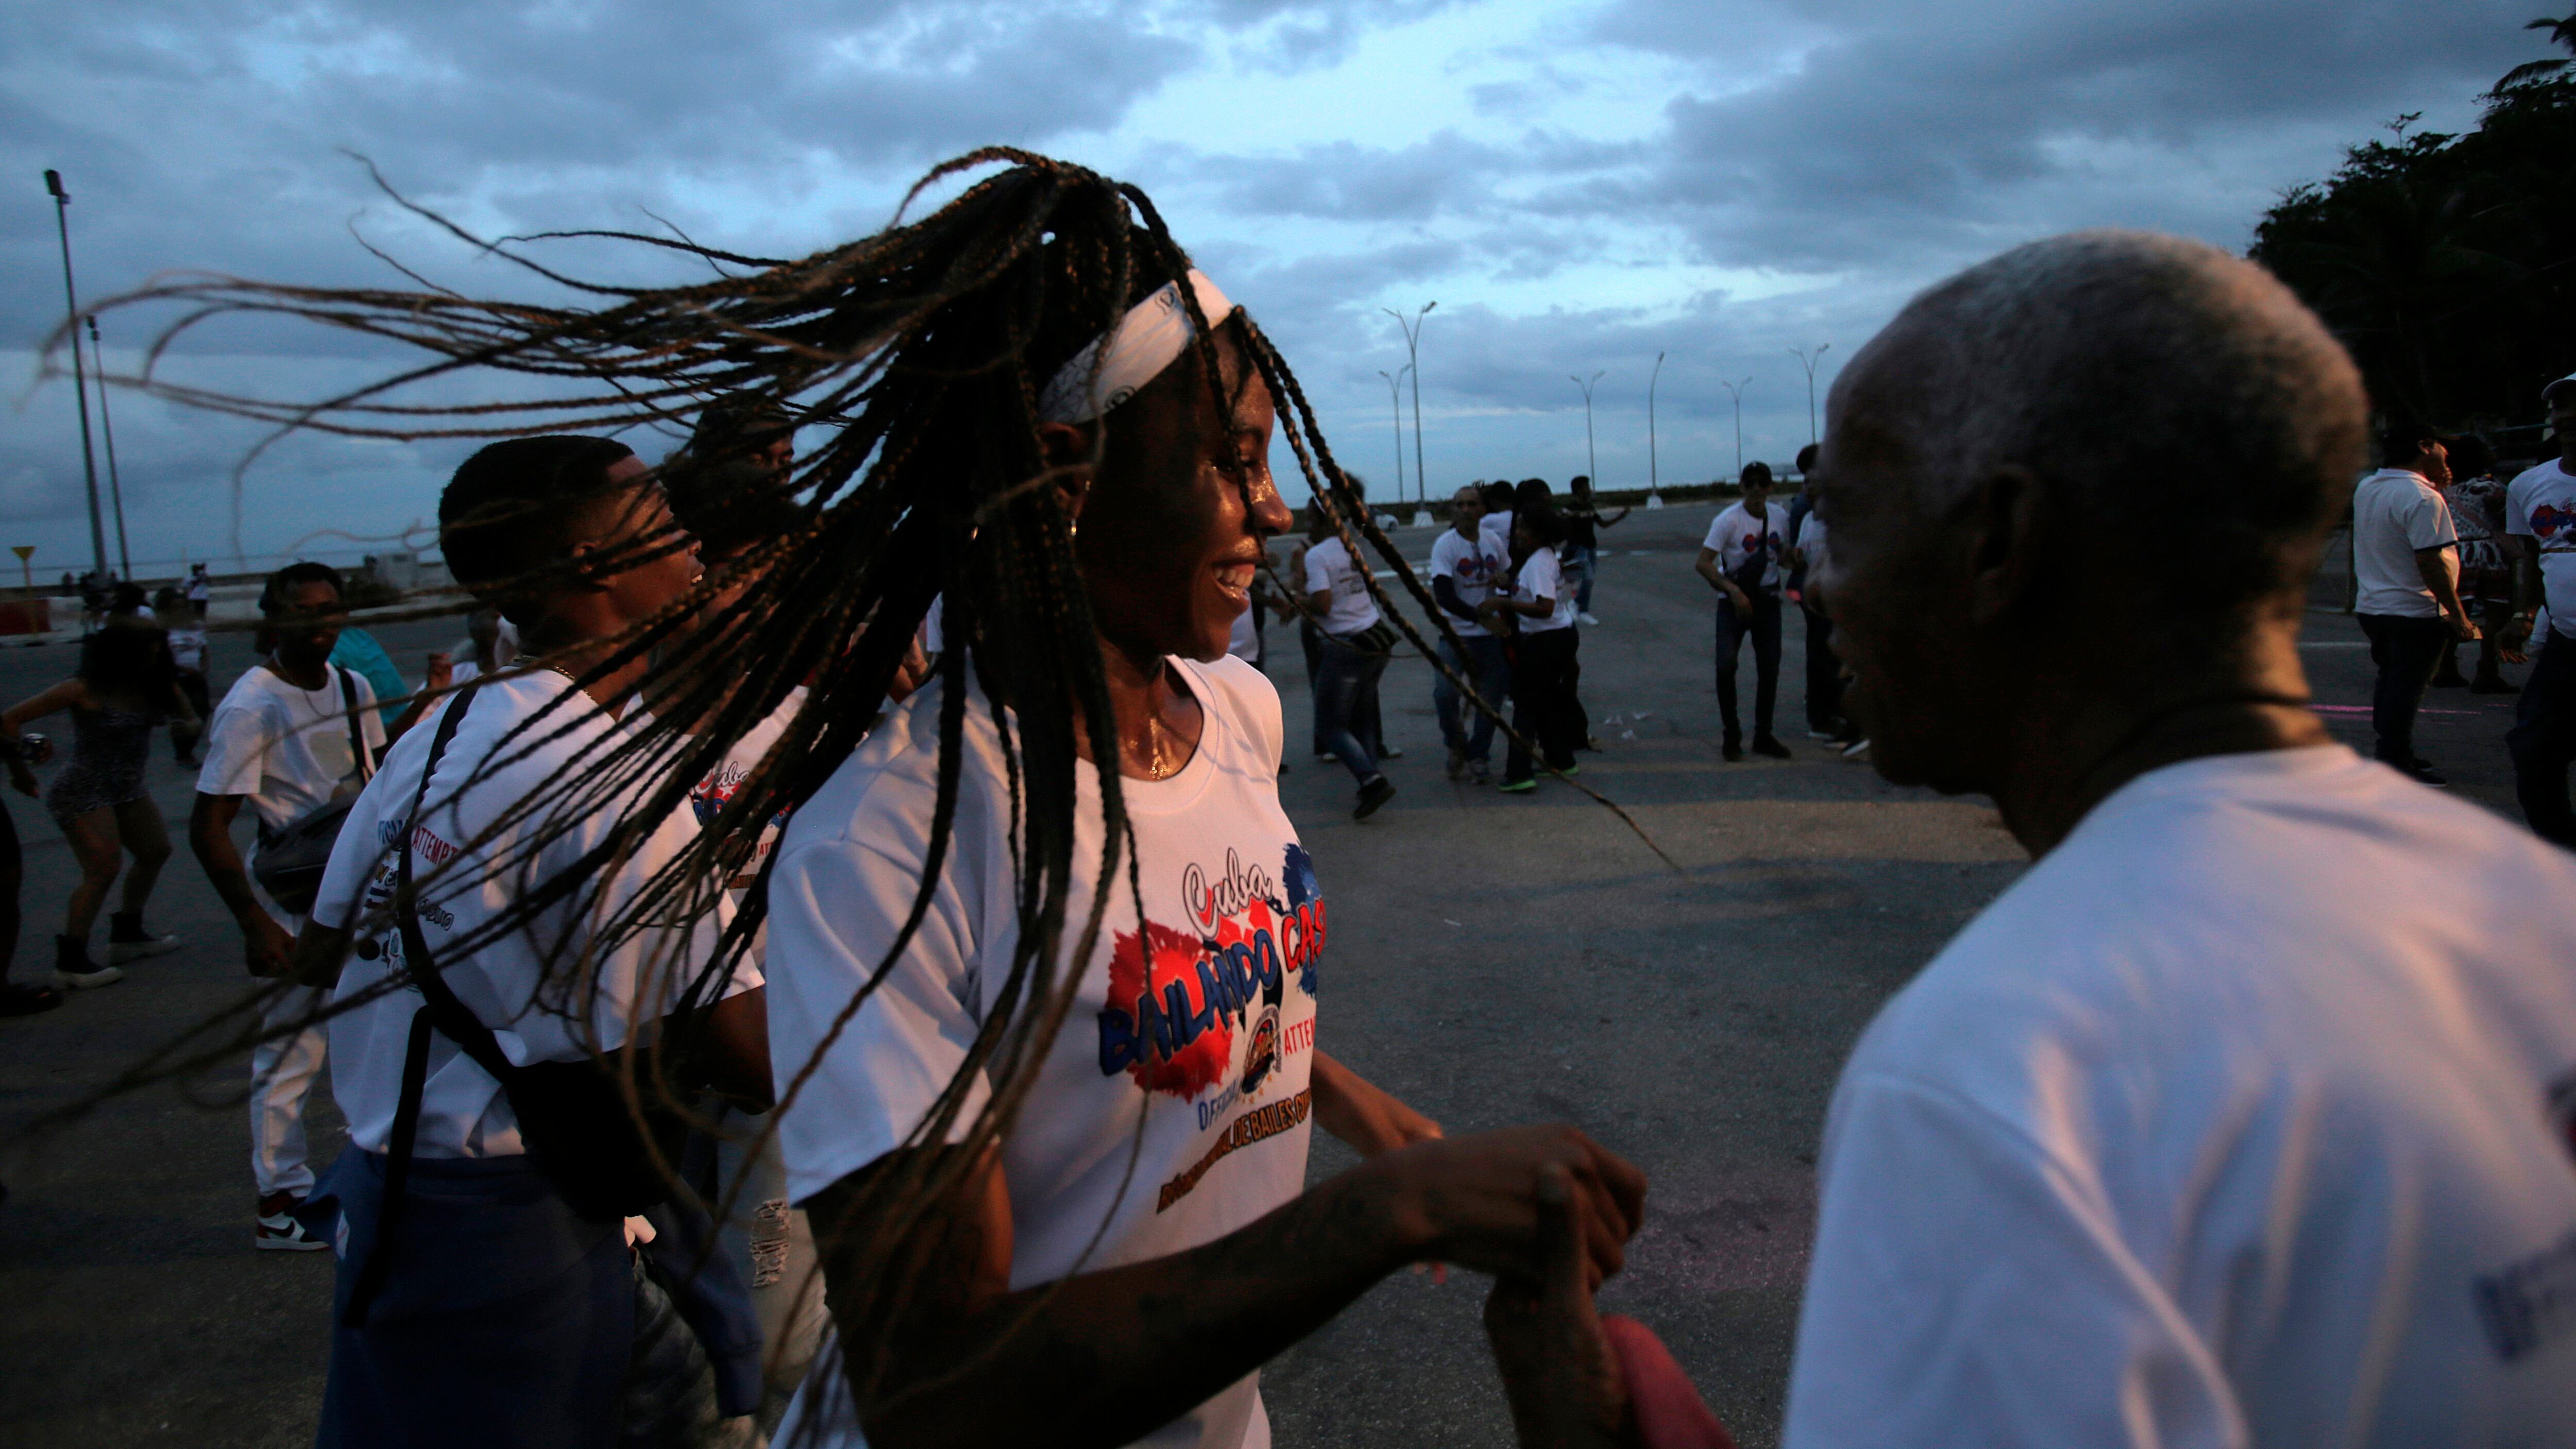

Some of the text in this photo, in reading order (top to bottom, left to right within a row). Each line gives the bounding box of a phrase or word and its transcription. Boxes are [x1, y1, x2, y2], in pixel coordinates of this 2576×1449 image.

[1183, 847, 1273, 941] Cuba
[1097, 929, 1279, 1076] BAILANDO
[1233, 1115, 1252, 1149] DE
[1249, 1098, 1296, 1142] BAILES
